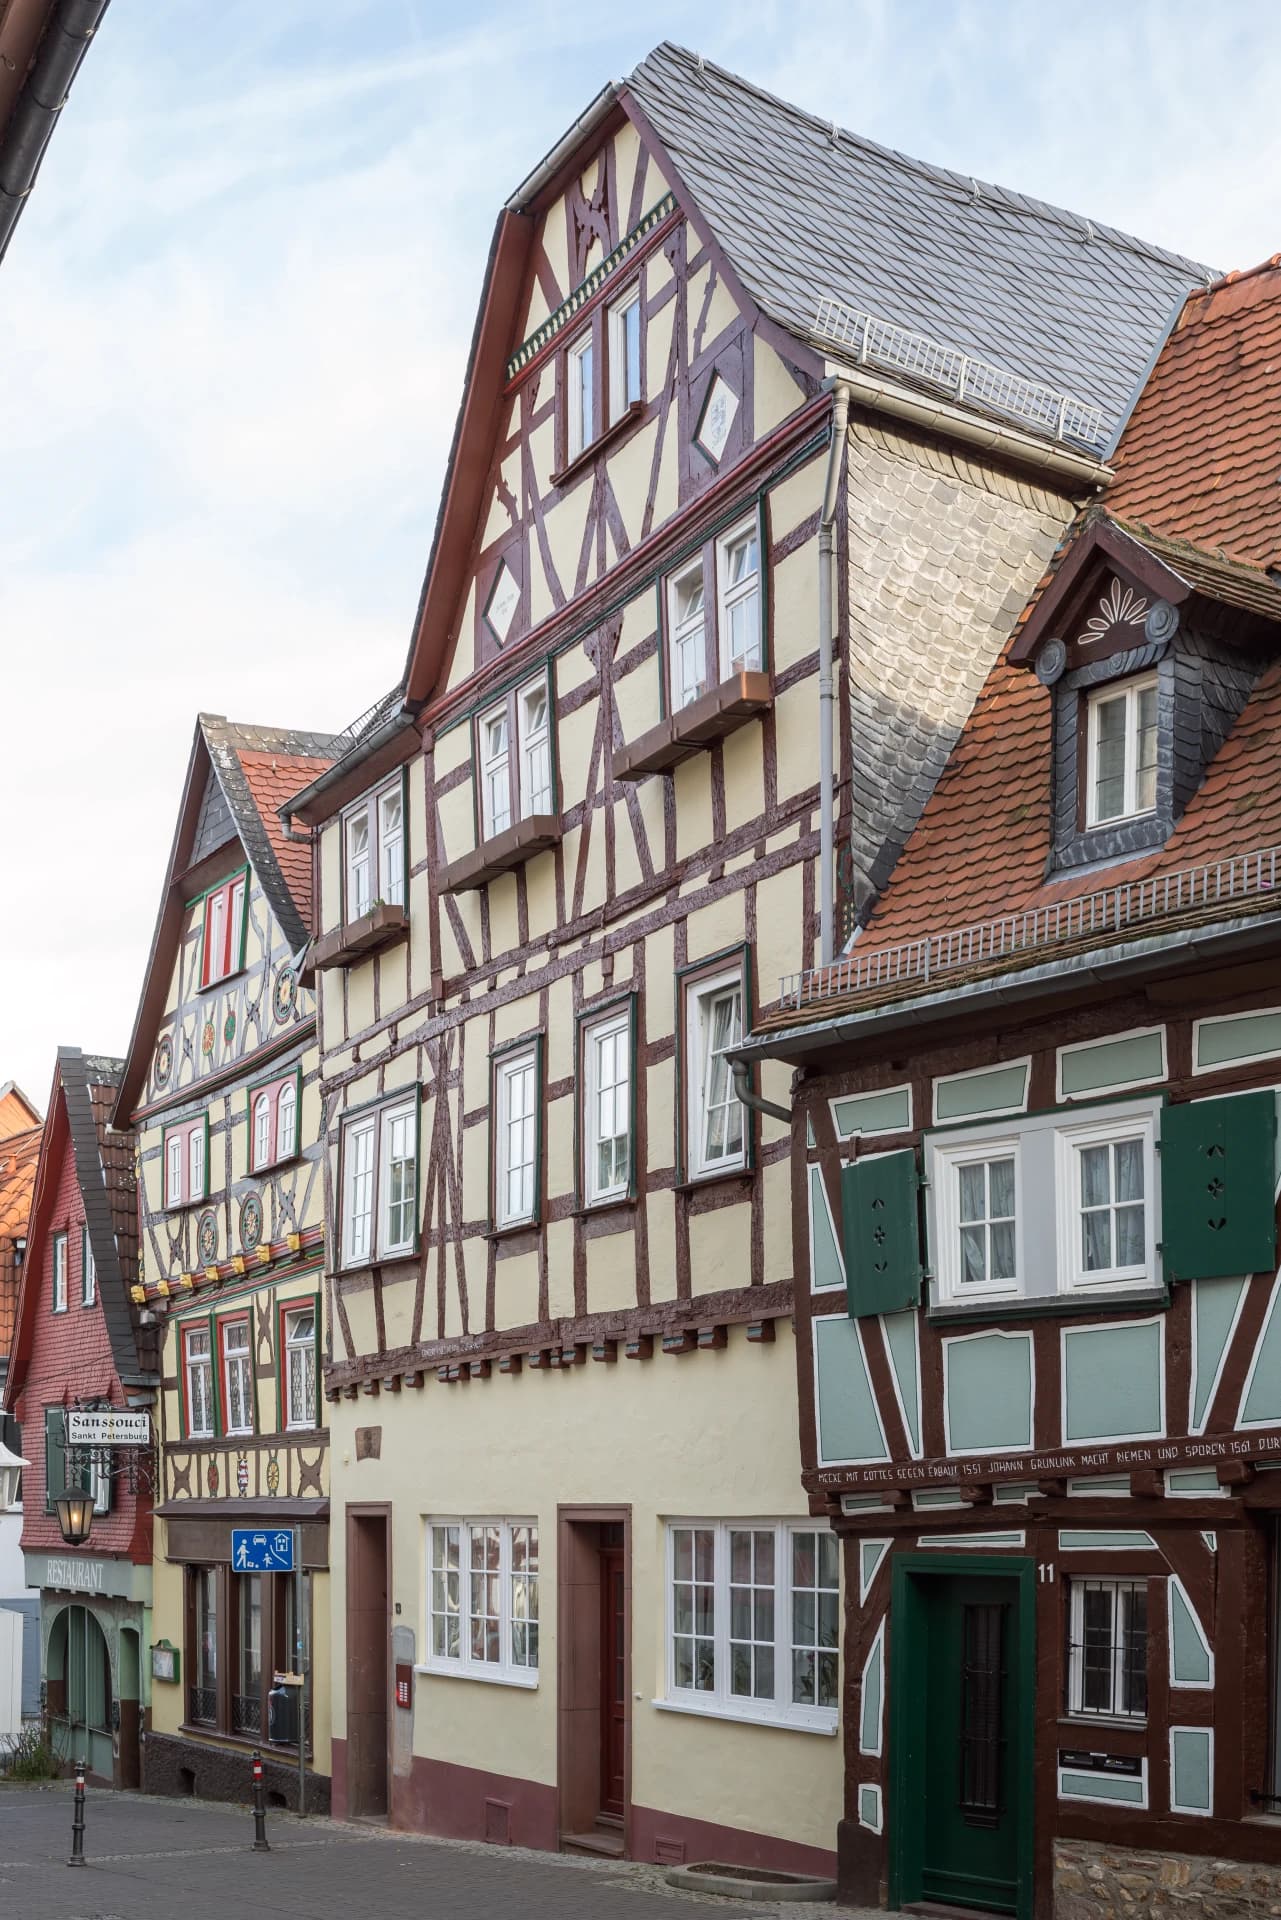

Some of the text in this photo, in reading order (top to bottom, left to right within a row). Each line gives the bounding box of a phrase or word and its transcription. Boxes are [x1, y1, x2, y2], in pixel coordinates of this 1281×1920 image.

[72, 1415, 147, 1428] Sanssouci
[71, 1432, 148, 1441] Sankt Petersburg
[846, 1471, 859, 1482] MIT
[863, 1470, 893, 1481] GOTTES
[963, 1463, 981, 1475] 1551
[988, 1460, 1024, 1473] JOHANN
[1081, 1452, 1109, 1465] MACHT
[1116, 1449, 1152, 1463] RIEMEN
[1157, 1447, 1178, 1459] UND
[1185, 1443, 1226, 1457] SPOREN
[1230, 1440, 1250, 1454] 1561
[1258, 1437, 1281, 1450] DUR
[47, 1559, 104, 1589] RESTAURANT
[1038, 1563, 1054, 1583] 11
